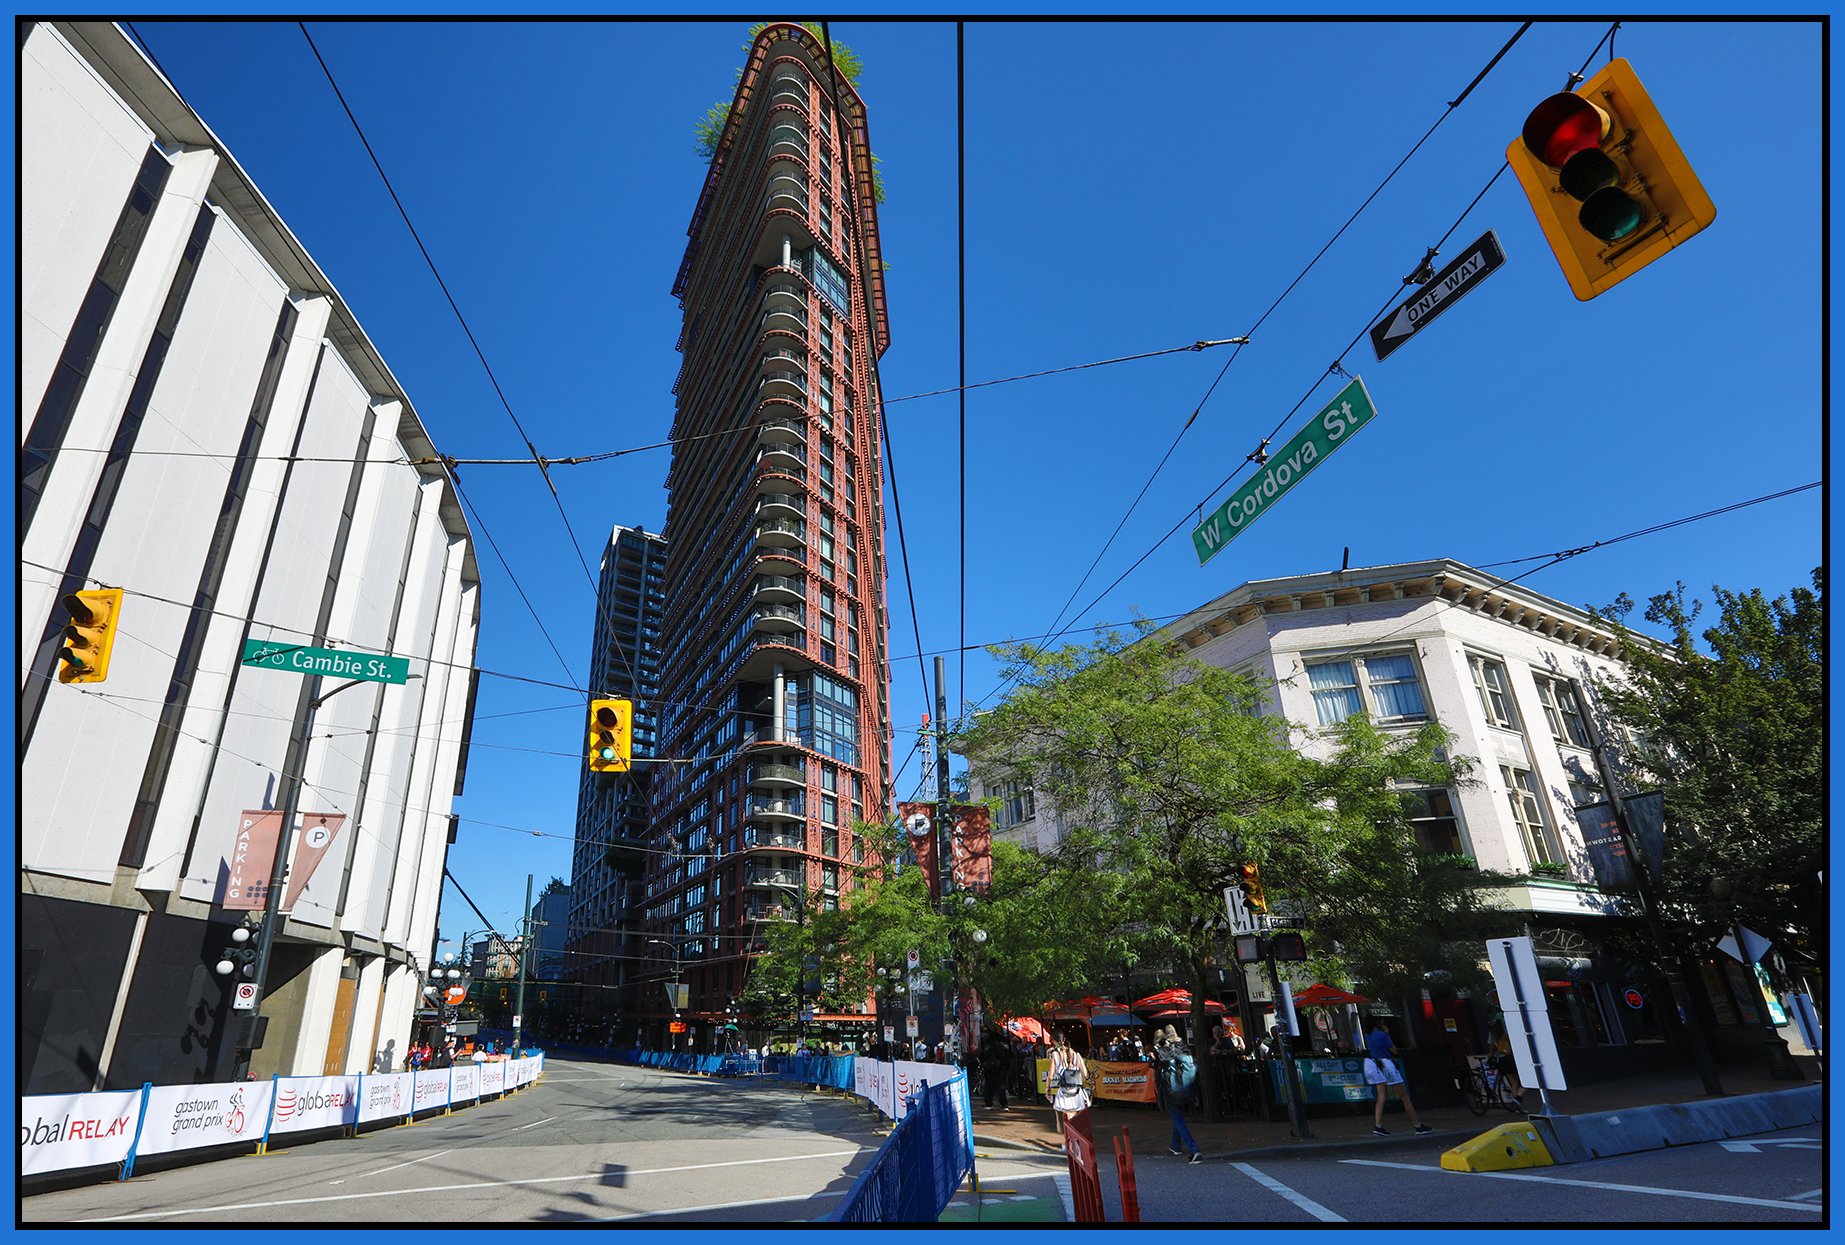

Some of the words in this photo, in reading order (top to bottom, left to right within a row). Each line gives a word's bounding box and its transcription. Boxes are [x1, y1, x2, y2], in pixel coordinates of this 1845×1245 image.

[1407, 289, 1440, 322] ONE
[1444, 255, 1479, 291] WAY
[1201, 517, 1221, 550] W
[1226, 440, 1319, 527] Cordova
[1323, 400, 1358, 441] St
[292, 650, 362, 675] Cambie
[366, 659, 392, 679] St.
[914, 818, 926, 830] P
[313, 831, 325, 843] P
[229, 819, 253, 898] PARKING
[1271, 918, 1294, 928] CAMBIE
[1252, 991, 1265, 999] LIVE
[174, 1098, 219, 1118] gastown
[171, 1113, 205, 1135] grand
[203, 1112, 224, 1131] prix
